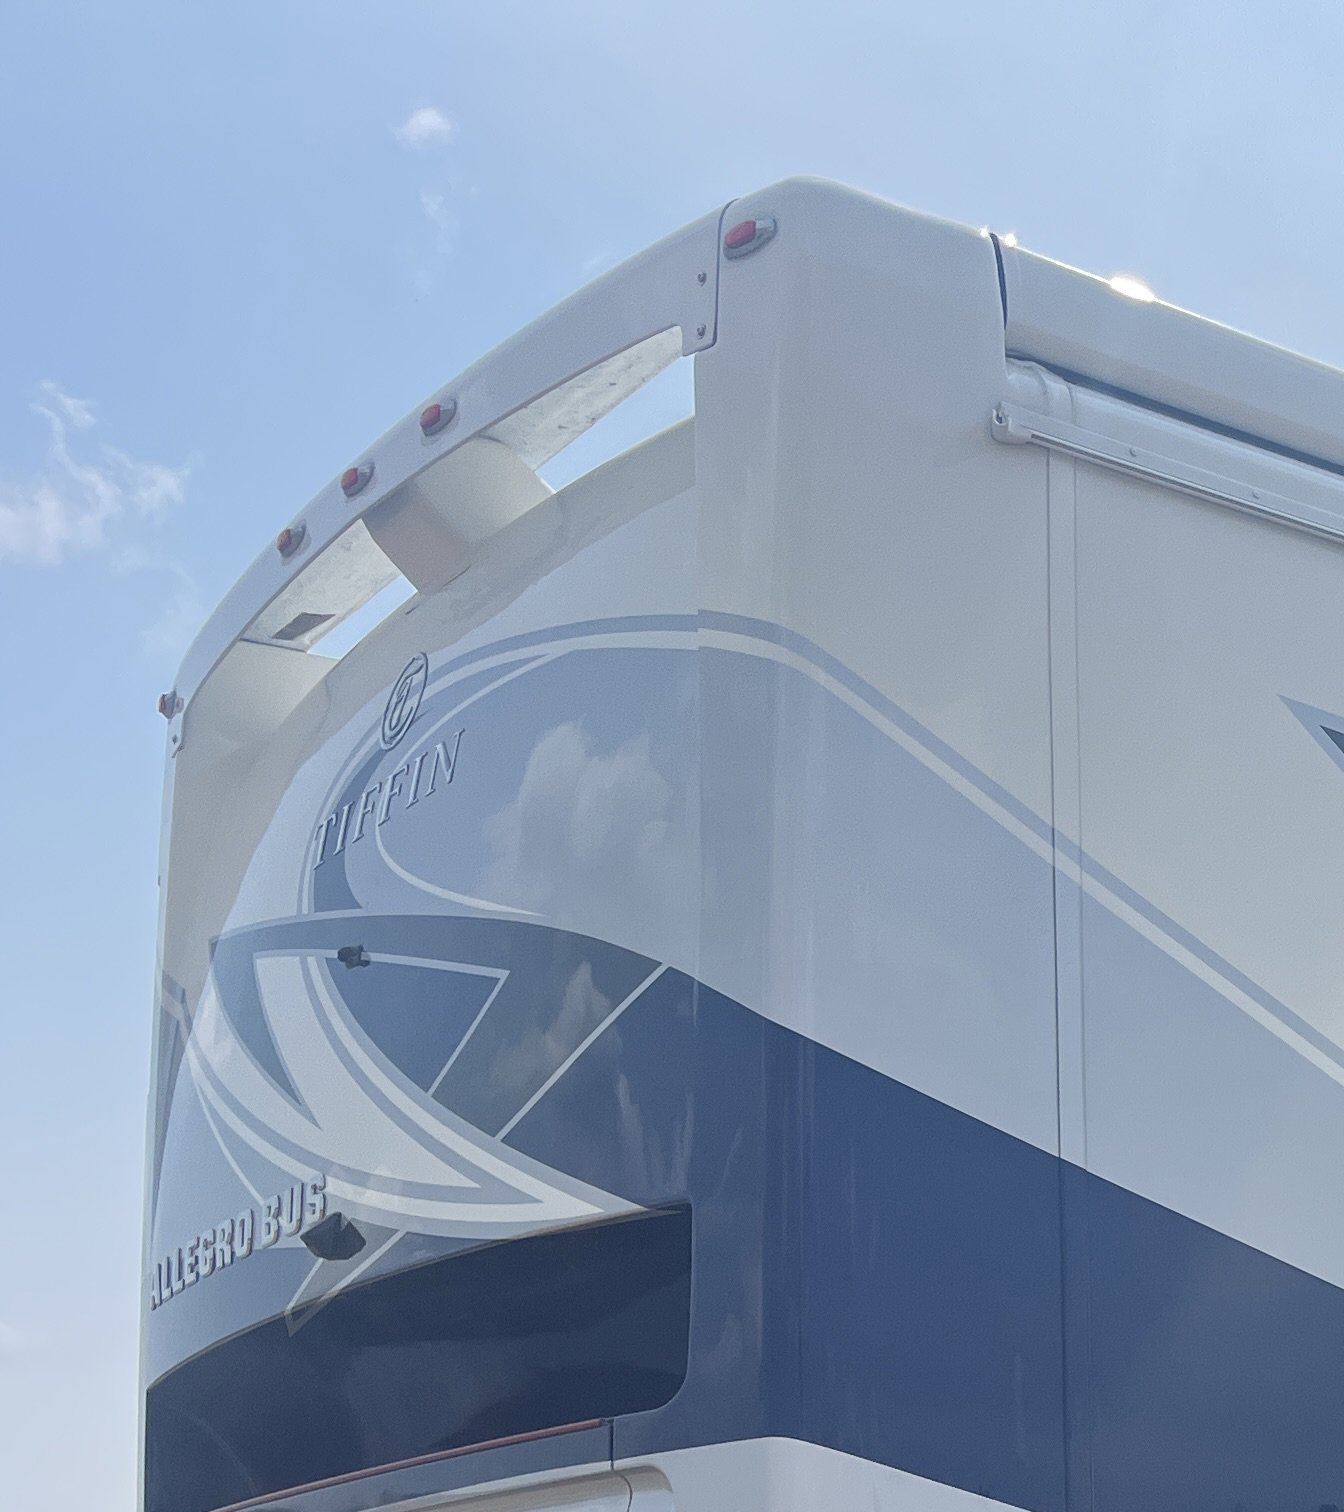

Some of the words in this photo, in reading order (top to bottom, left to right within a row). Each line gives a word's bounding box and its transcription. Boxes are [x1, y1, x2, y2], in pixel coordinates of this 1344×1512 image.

[313, 728, 466, 870] TIFFIN
[150, 1208, 255, 1312] ALLEGRO
[261, 1172, 327, 1250] BUS
